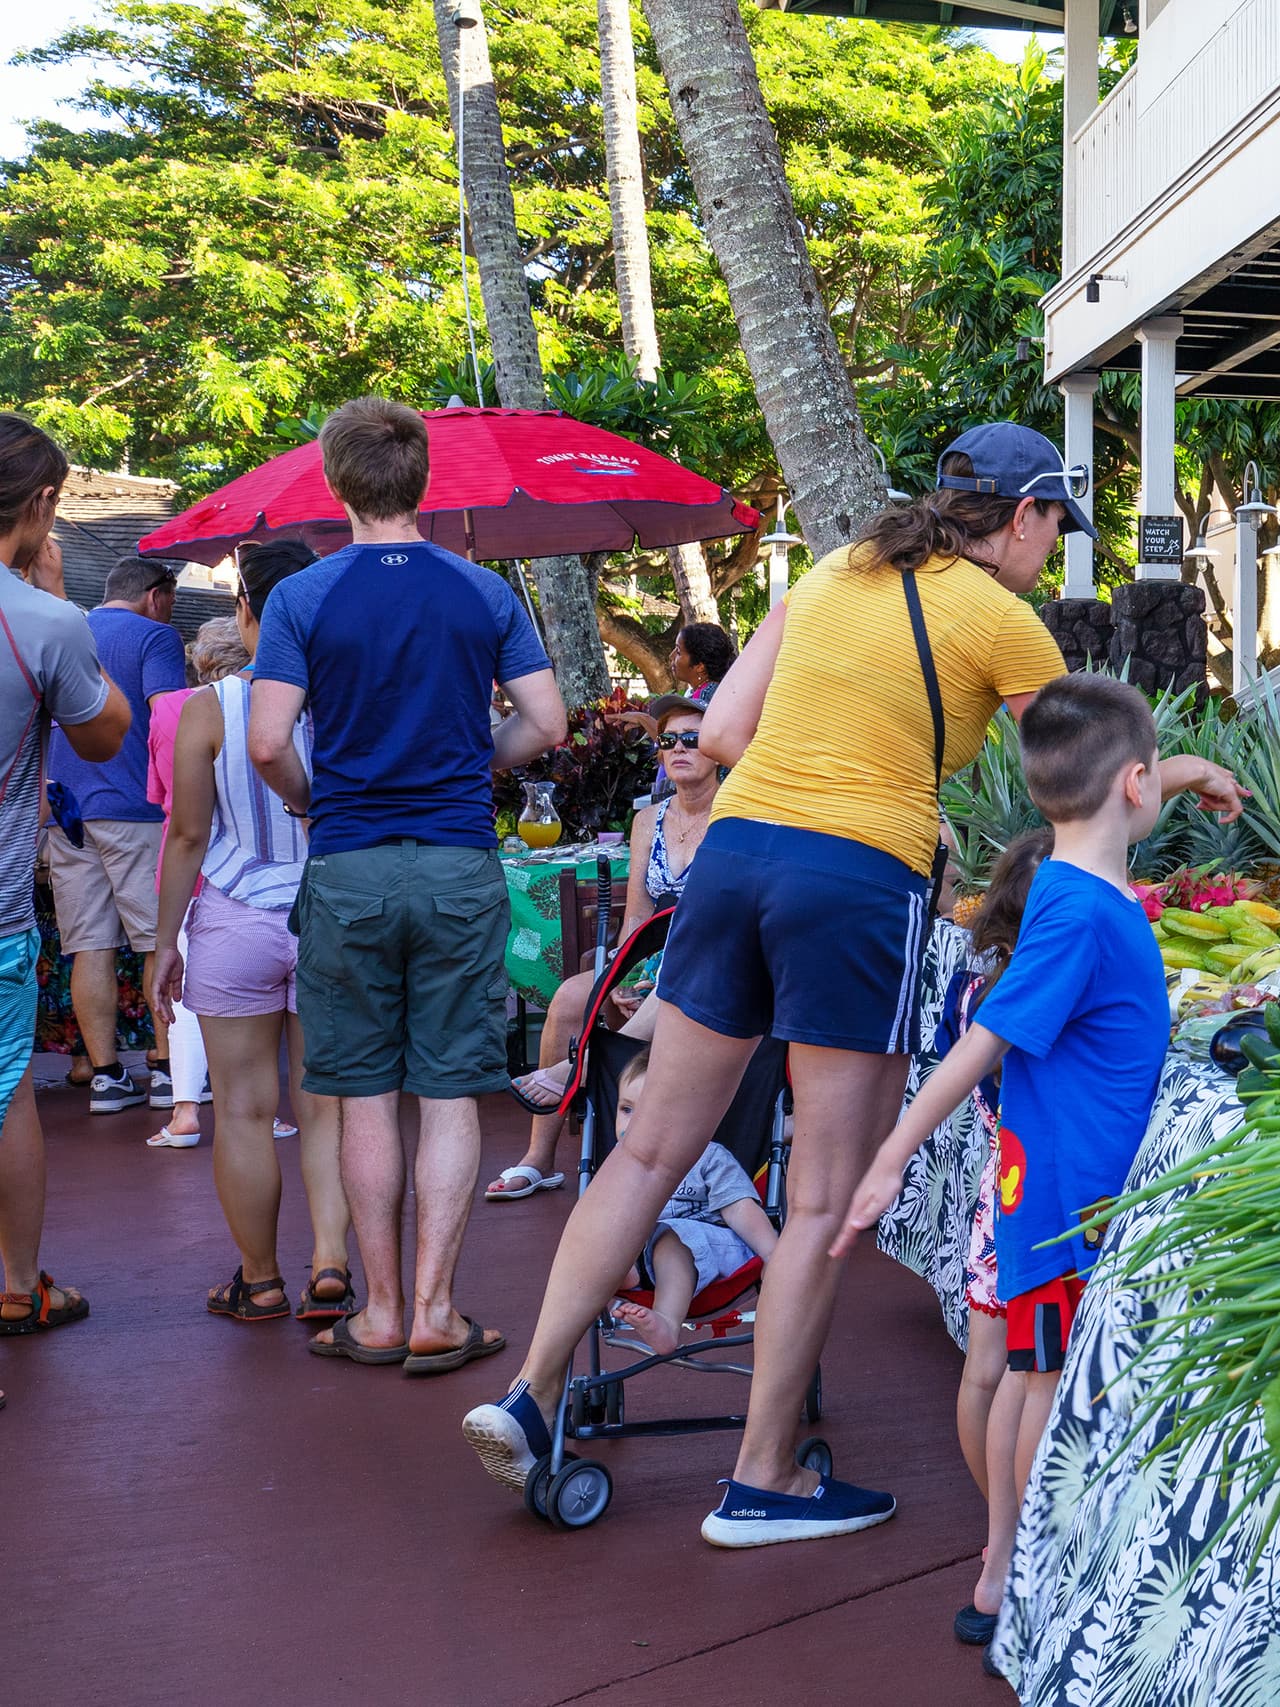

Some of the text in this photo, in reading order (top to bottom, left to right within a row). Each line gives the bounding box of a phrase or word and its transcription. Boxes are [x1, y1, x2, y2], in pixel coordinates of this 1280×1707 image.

[1144, 528, 1170, 536] WATCH
[1144, 537, 1166, 545] YOUR
[1144, 545, 1164, 553] STEP
[730, 1508, 767, 1518] adidas
